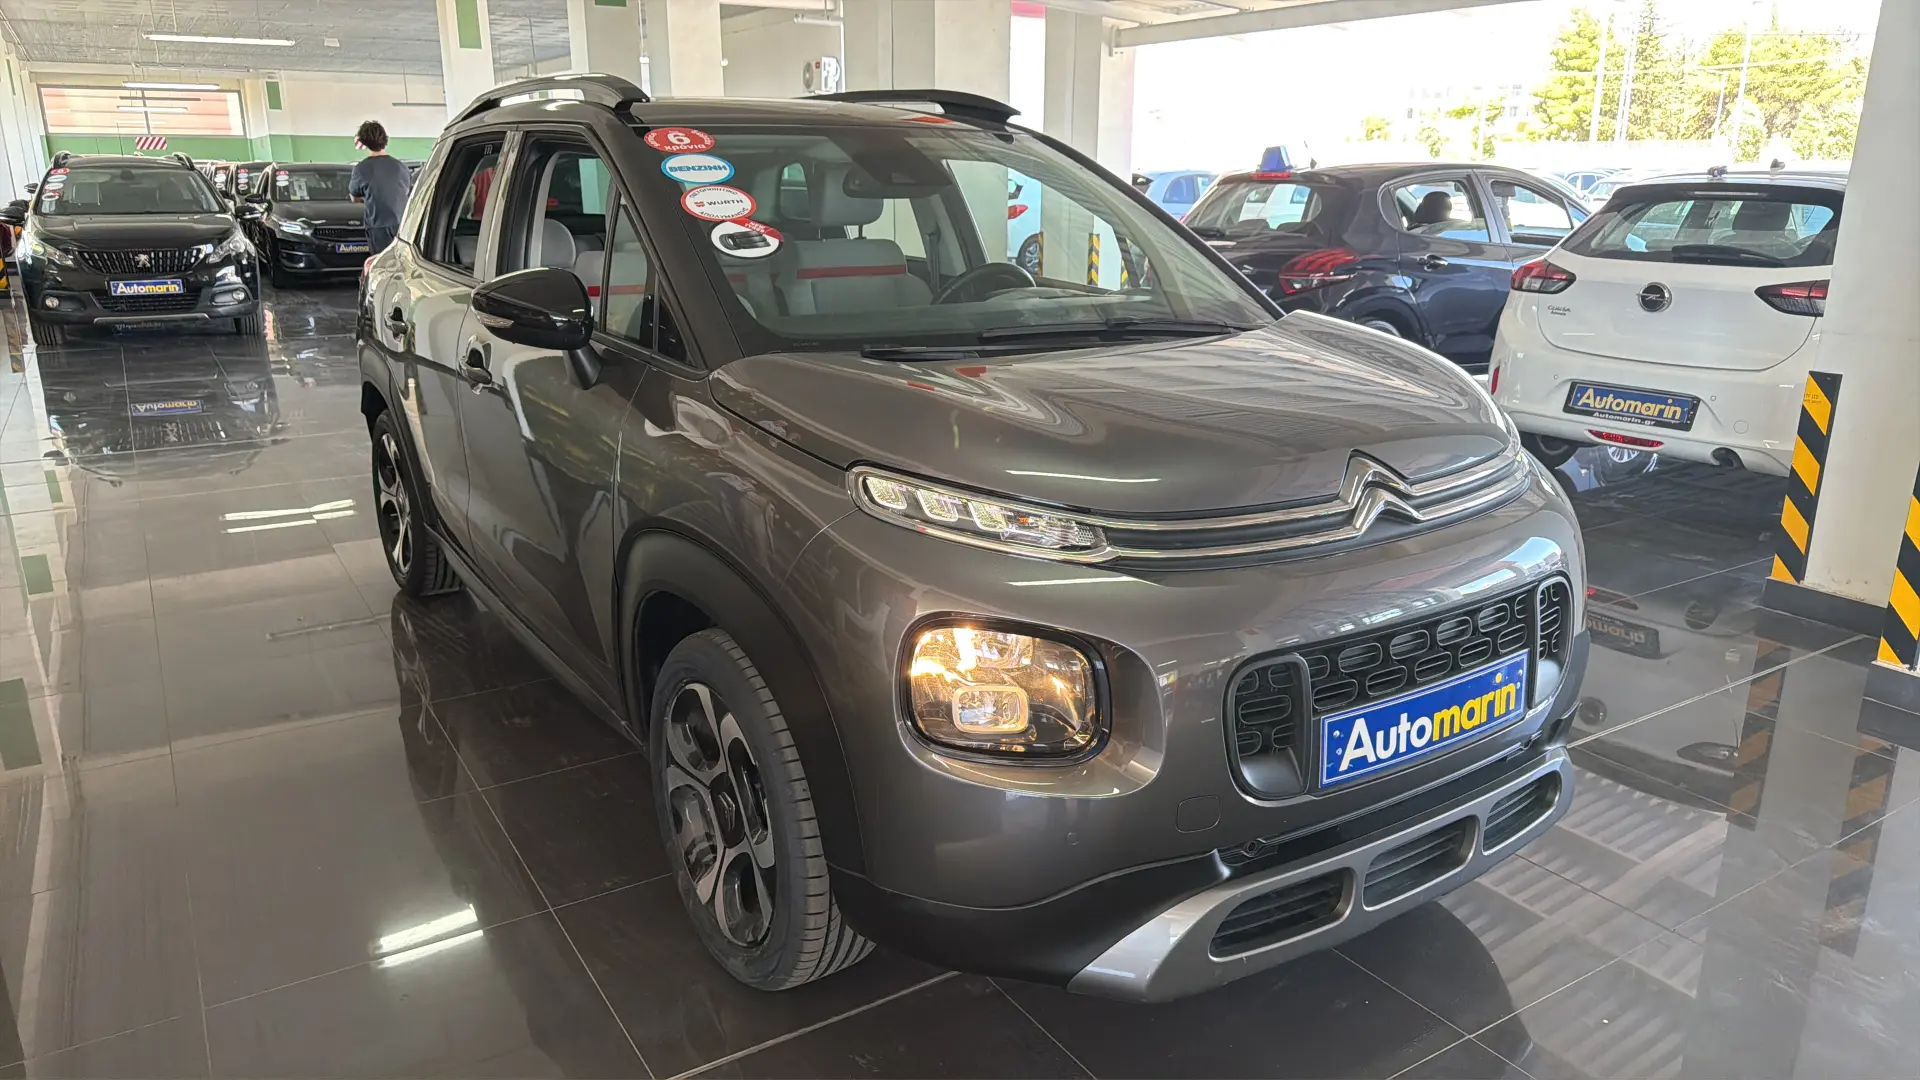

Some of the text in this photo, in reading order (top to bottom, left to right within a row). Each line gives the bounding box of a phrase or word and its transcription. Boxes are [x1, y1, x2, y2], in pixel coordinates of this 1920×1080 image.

[667, 132, 691, 145] 6
[340, 243, 370, 253] Automa
[117, 281, 180, 294] Automarin
[1578, 387, 1682, 420] Automarin
[1592, 411, 1656, 425] Automarin.gr
[1338, 672, 1517, 772] Automarin
